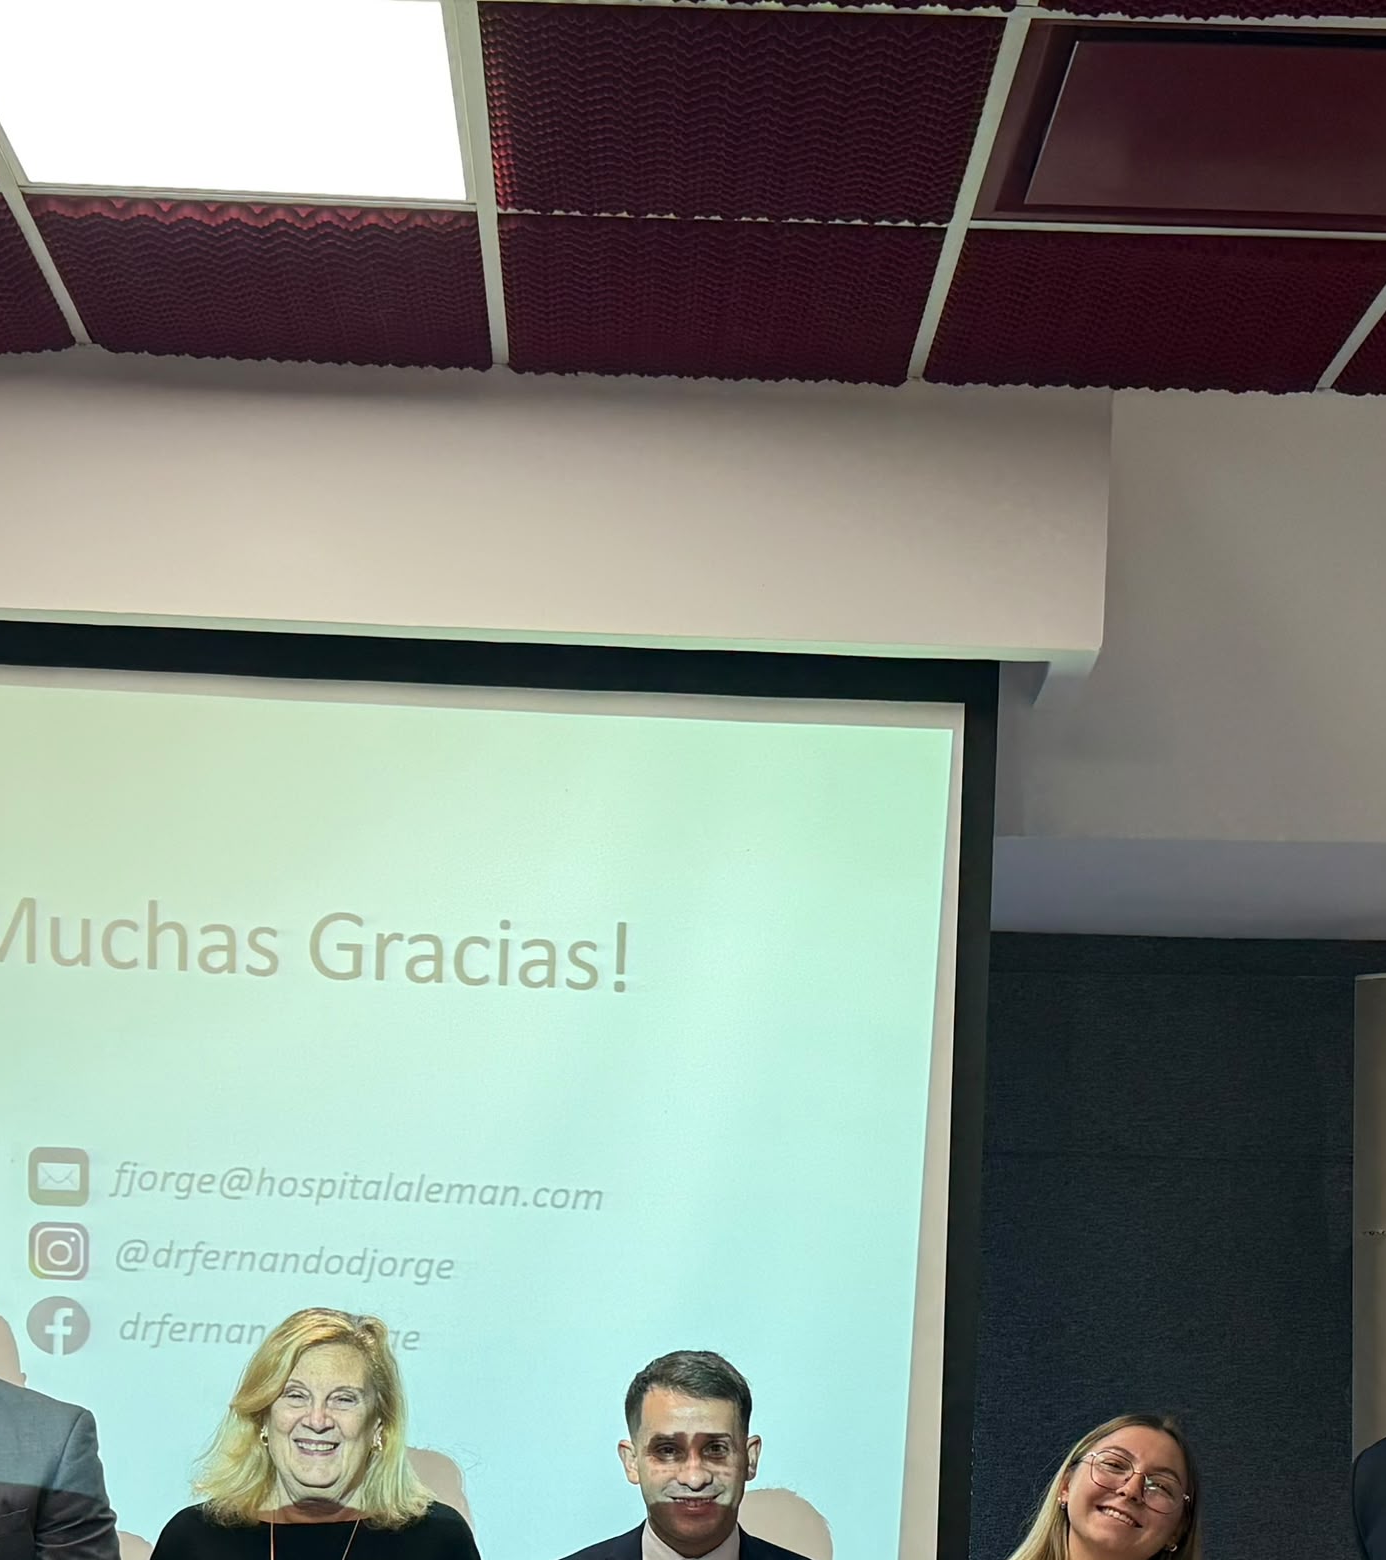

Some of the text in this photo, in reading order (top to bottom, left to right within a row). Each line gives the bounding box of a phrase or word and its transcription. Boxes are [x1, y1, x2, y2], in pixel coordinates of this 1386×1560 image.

[309, 912, 629, 994] Gracias!
[109, 1161, 604, 1212] fjorge@hospitalaleman.com
[115, 1239, 455, 1286] @drfernandodjorge
